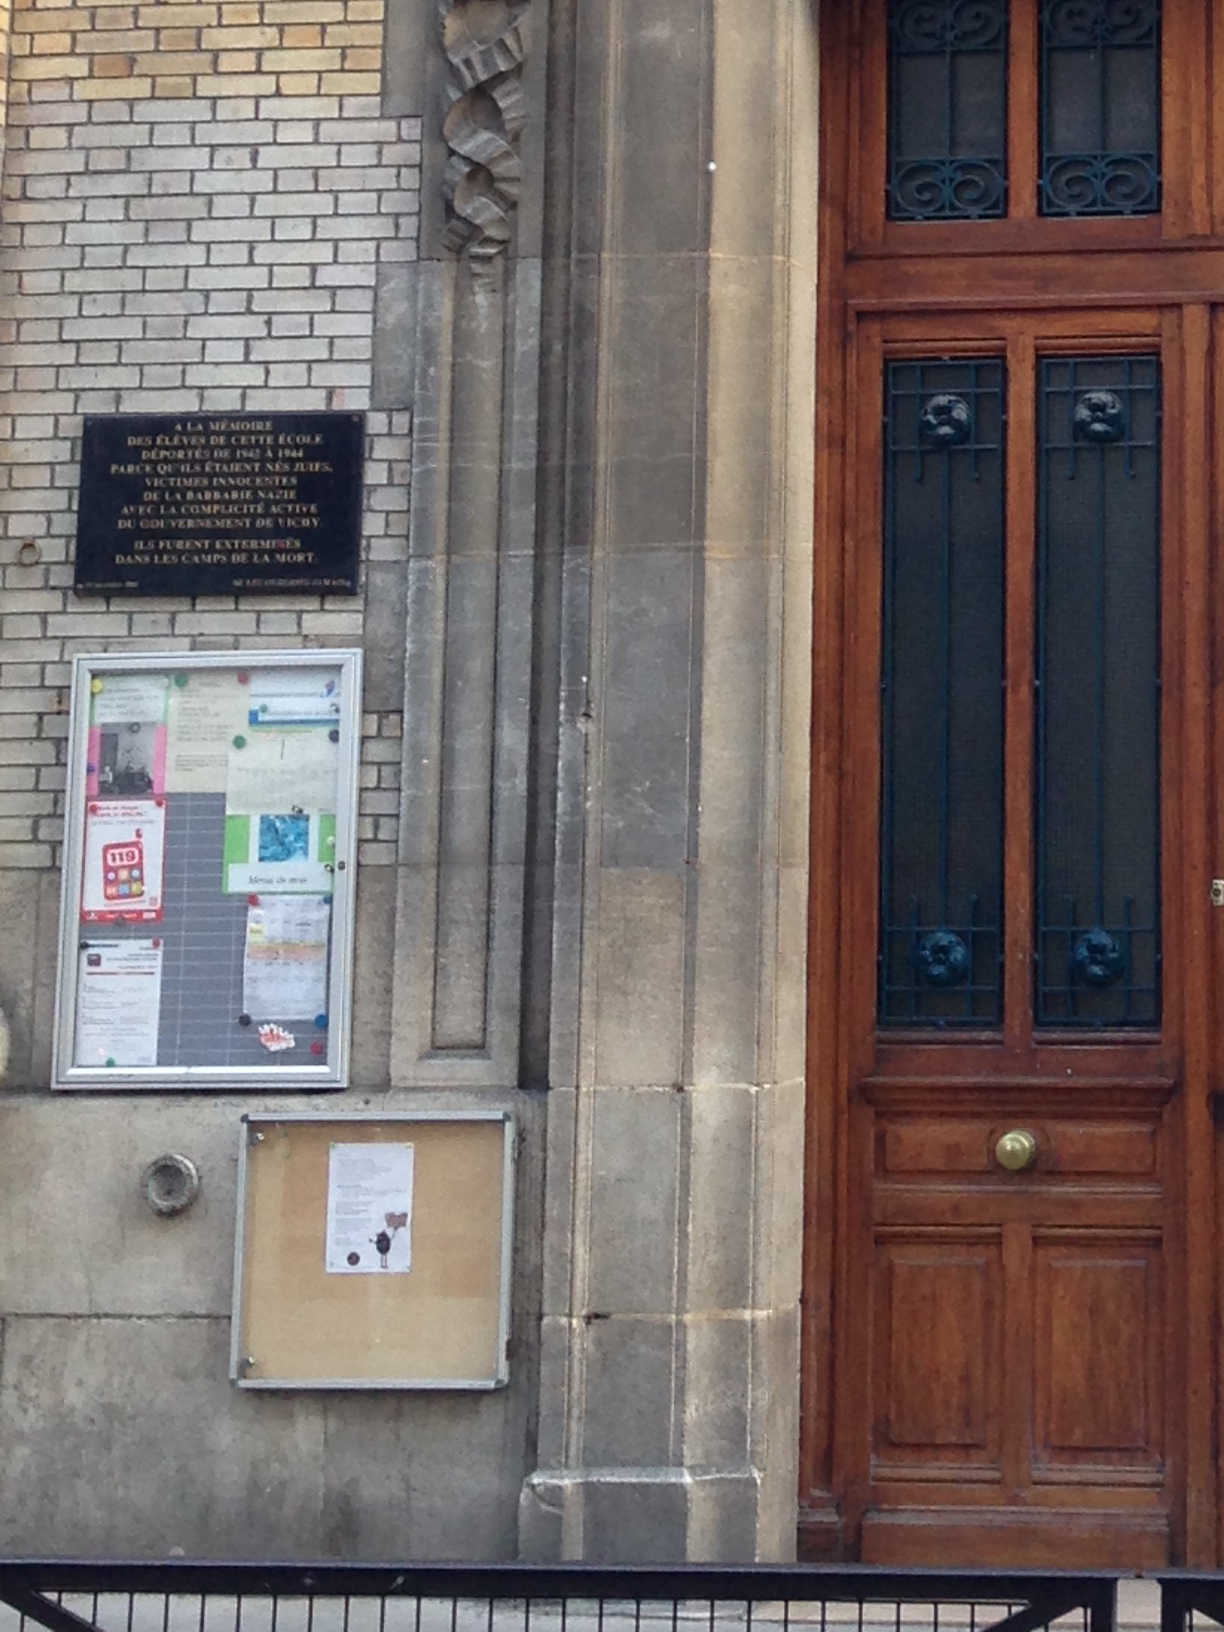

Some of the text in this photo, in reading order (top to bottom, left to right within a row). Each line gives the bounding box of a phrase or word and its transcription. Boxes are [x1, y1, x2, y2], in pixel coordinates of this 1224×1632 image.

[187, 421, 204, 431] LA
[209, 419, 272, 431] MÉMOIRE
[127, 436, 152, 446] DES
[210, 435, 225, 445] DE
[230, 434, 274, 445] CETTE
[278, 432, 323, 444] ÉCOLE
[141, 448, 210, 460] DÉPORTÉS
[213, 449, 230, 459] DE
[278, 448, 303, 458] 1944
[205, 460, 261, 473] ÉTAIENT
[145, 476, 298, 487] VICTIMES INNOCENTES
[143, 489, 297, 501] DE LA BARBARIE NAZIE
[121, 502, 318, 515] AVEC LA COMPLICITÉ ACTIVE
[117, 519, 136, 529] DU
[139, 518, 252, 529] GOUVERNEMENT
[256, 518, 273, 528] DE
[159, 539, 210, 550] FURENT
[115, 554, 150, 564] DANS
[154, 554, 178, 564] LES
[181, 553, 227, 564] CAMPS
[231, 553, 249, 564] DE
[252, 553, 270, 563] LA
[110, 850, 136, 864] 119
